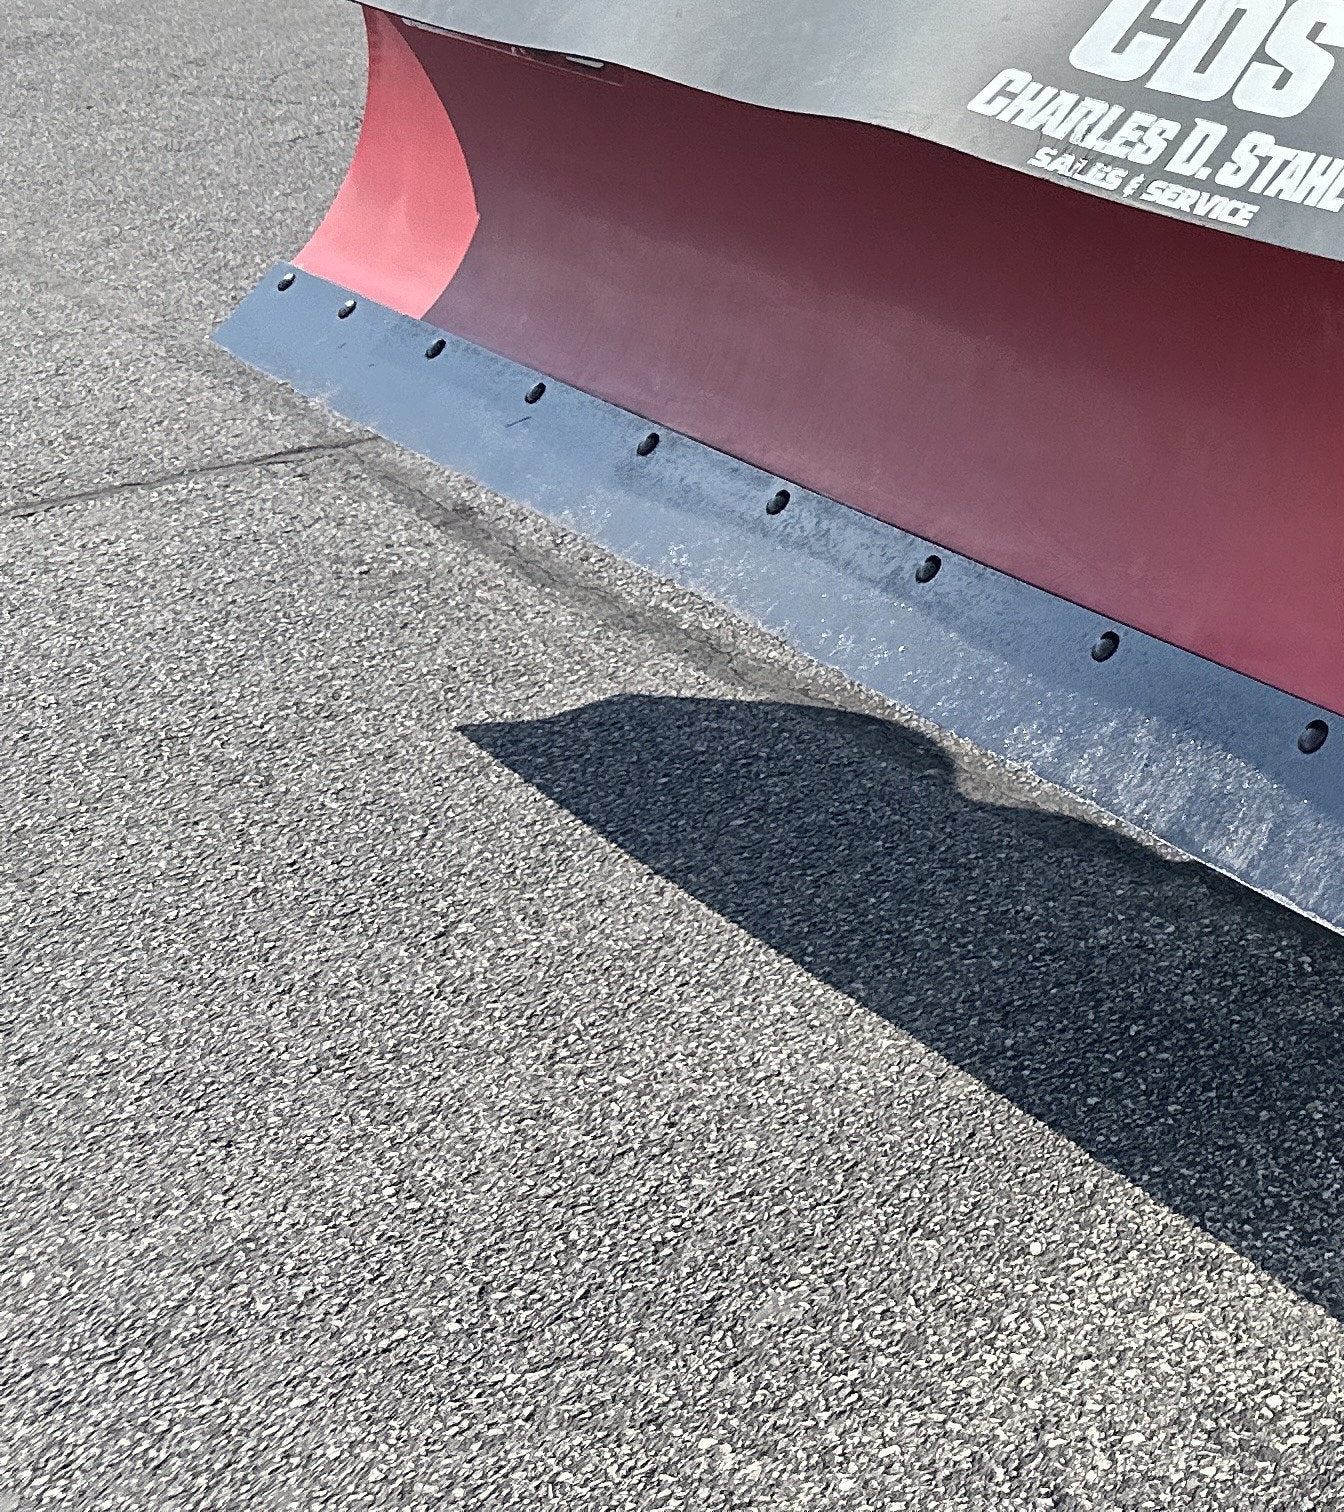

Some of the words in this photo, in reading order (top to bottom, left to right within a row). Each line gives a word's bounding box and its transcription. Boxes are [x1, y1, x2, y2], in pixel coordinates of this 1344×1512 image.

[966, 67, 1182, 165] CHARLES
[1164, 117, 1228, 180] D.
[1027, 145, 1129, 192] SALES
[1139, 179, 1261, 228] SERVICE
